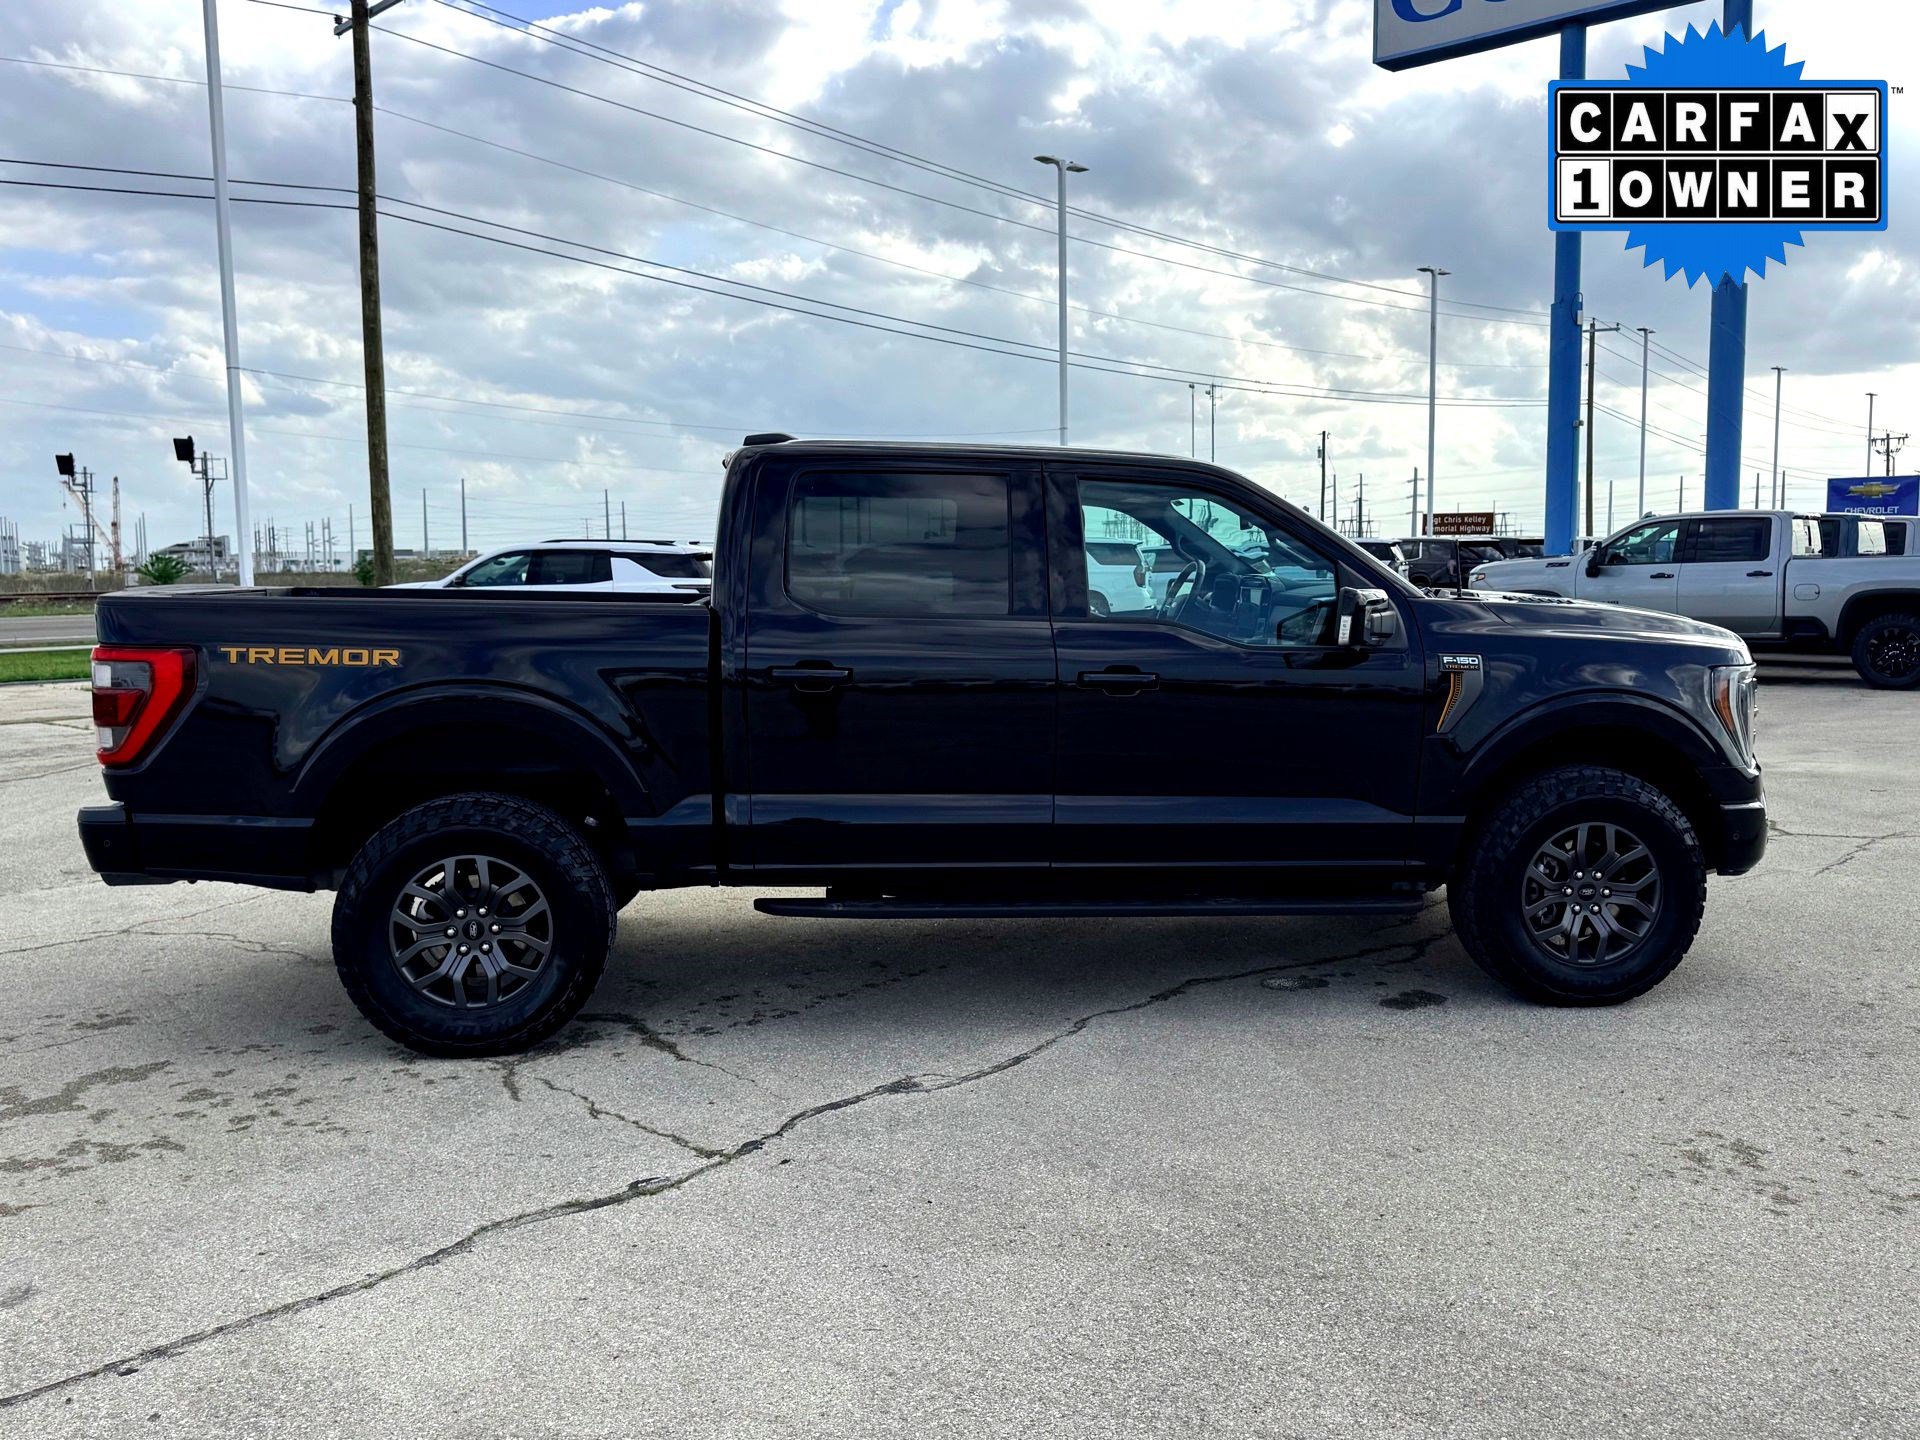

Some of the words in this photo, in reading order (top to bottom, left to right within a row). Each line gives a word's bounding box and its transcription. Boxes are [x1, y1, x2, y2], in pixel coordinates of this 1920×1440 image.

[1844, 506, 1899, 514] CHEVROLET
[1443, 516, 1462, 524] Chris
[1464, 515, 1486, 525] Kelley
[1425, 525, 1457, 533] morial
[1459, 524, 1491, 534] Highway
[220, 647, 400, 666] TREMOR
[1443, 656, 1478, 664] F-150
